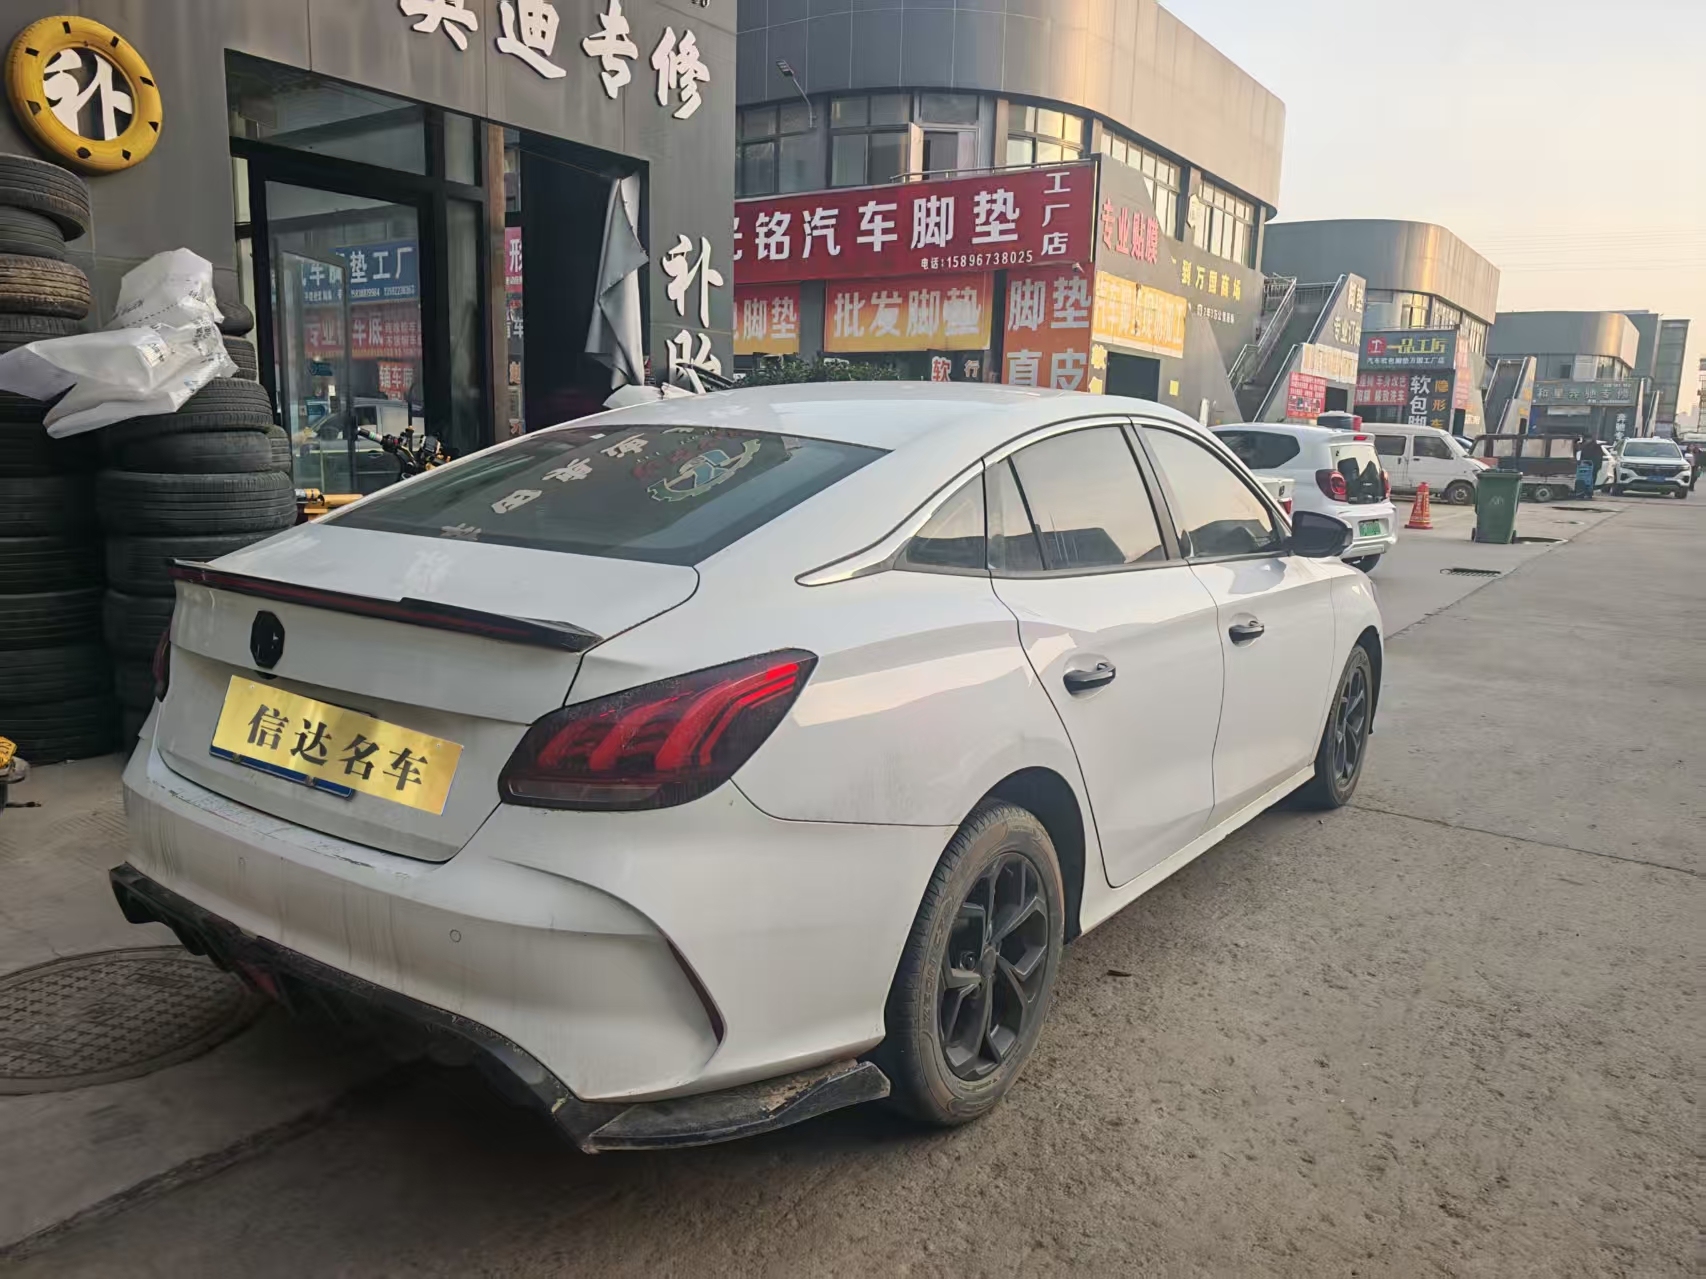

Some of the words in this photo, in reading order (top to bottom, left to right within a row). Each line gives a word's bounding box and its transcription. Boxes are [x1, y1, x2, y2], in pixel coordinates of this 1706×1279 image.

[1041, 171, 1072, 256] 工厂店
[733, 296, 798, 341] 脚垫
[834, 286, 982, 338] 批发脚垫
[1007, 275, 1092, 332] 脚垫
[247, 704, 428, 790] 信达名车
